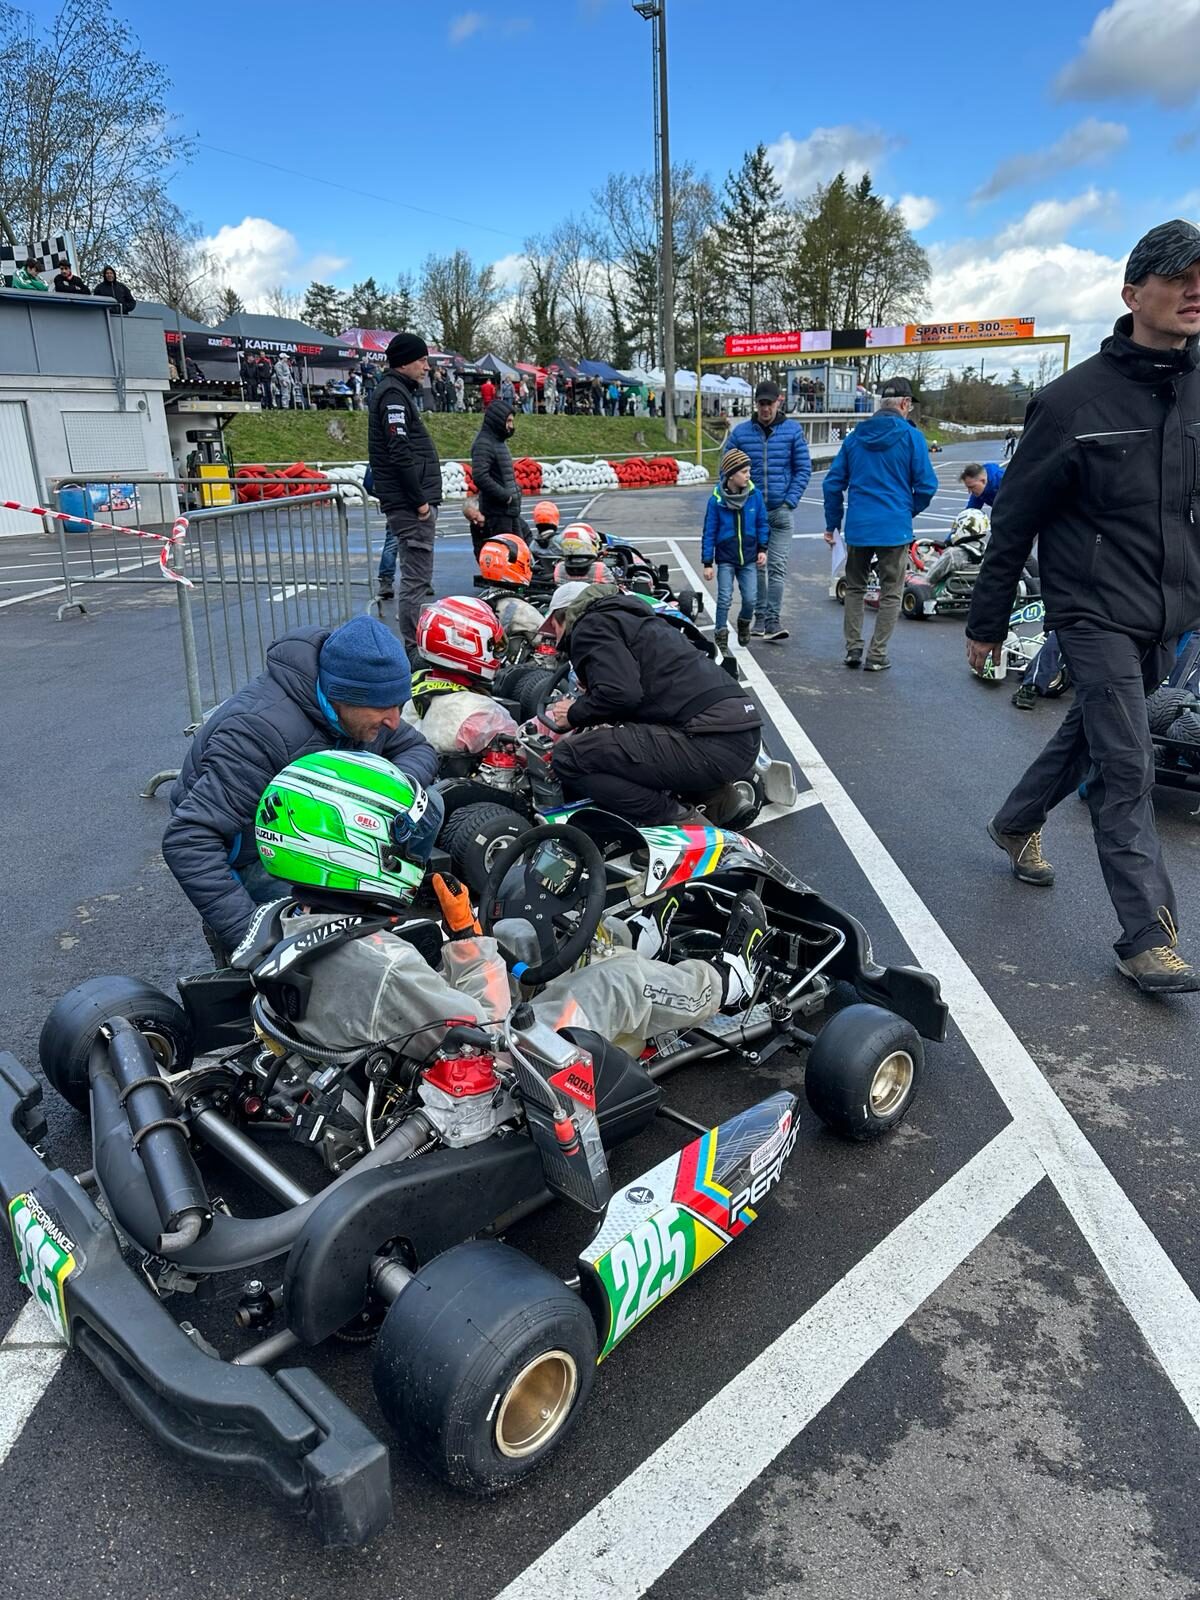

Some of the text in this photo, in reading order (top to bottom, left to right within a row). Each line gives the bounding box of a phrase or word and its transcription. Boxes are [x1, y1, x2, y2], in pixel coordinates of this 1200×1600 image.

[916, 325, 954, 335] SPARE
[958, 324, 973, 333] Fr.
[732, 335, 799, 346] Eintauschaktion für
[769, 342, 798, 351] Motoren
[357, 815, 377, 828] BELL
[564, 1081, 592, 1101] RACING
[567, 1073, 594, 1096] ROTAX
[24, 1191, 75, 1254] PERFORMANCE
[612, 1203, 686, 1342] 225
